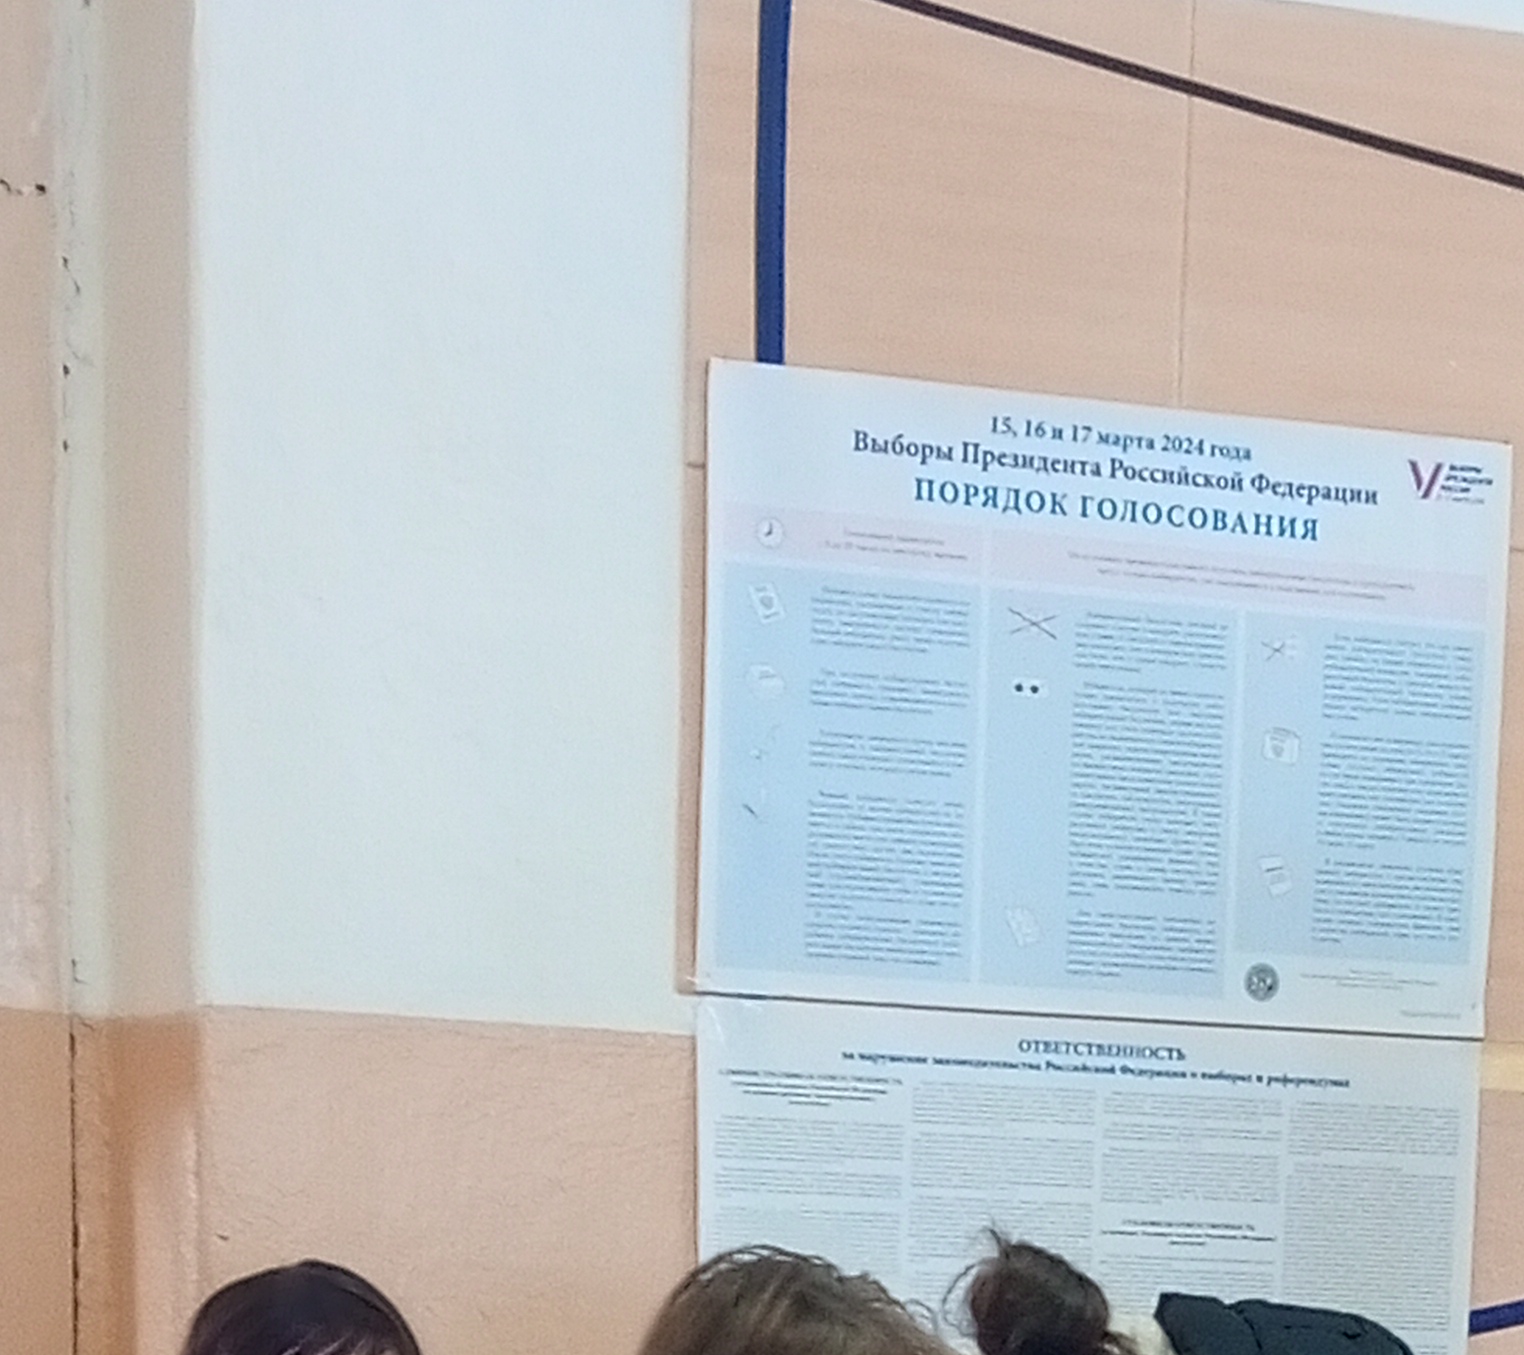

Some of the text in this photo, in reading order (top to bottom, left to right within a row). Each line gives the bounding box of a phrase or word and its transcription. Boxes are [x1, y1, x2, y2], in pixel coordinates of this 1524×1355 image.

[990, 415, 1252, 461] 15, 16 и 17 марта 2024 года
[853, 429, 1379, 506] Выборы Президента Российской Федерации
[914, 476, 1319, 541] ПОРЯДОК ГОЛОСОВАНИЯ
[1018, 1038, 1186, 1061] ОТВЕТСТВЕННОСТЬ
